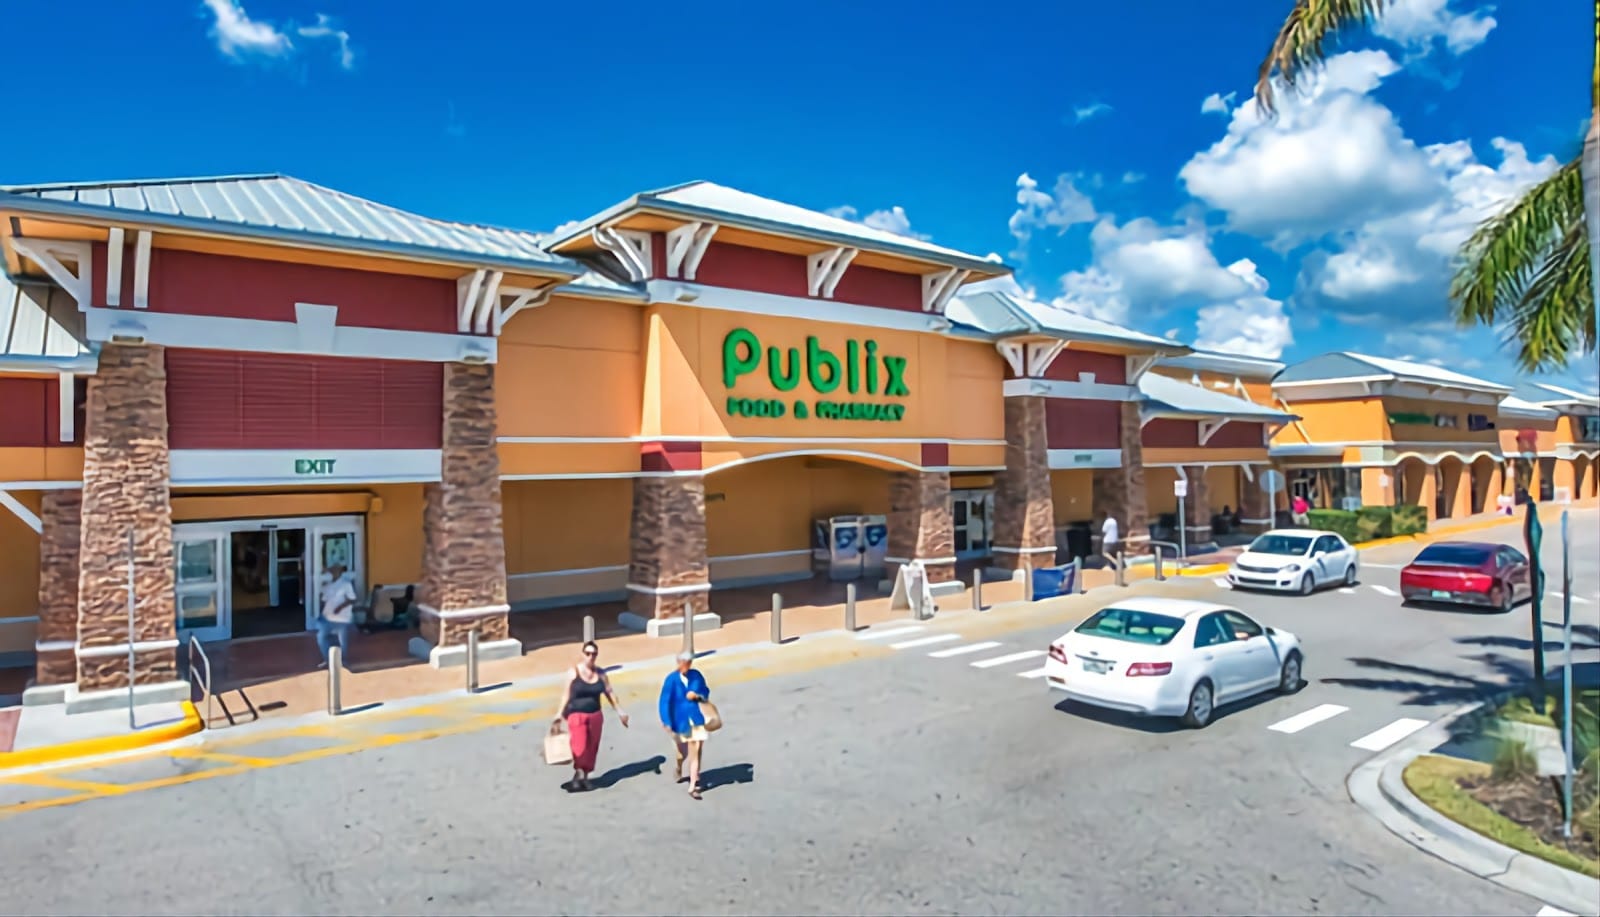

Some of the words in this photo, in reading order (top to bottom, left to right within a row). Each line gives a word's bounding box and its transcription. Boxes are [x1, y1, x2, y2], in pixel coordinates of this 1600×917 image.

[723, 327, 909, 396] Publix
[726, 396, 786, 418] FOOD
[794, 399, 808, 419] &
[815, 400, 905, 421] PHARMACY
[294, 459, 336, 474] EXIT
